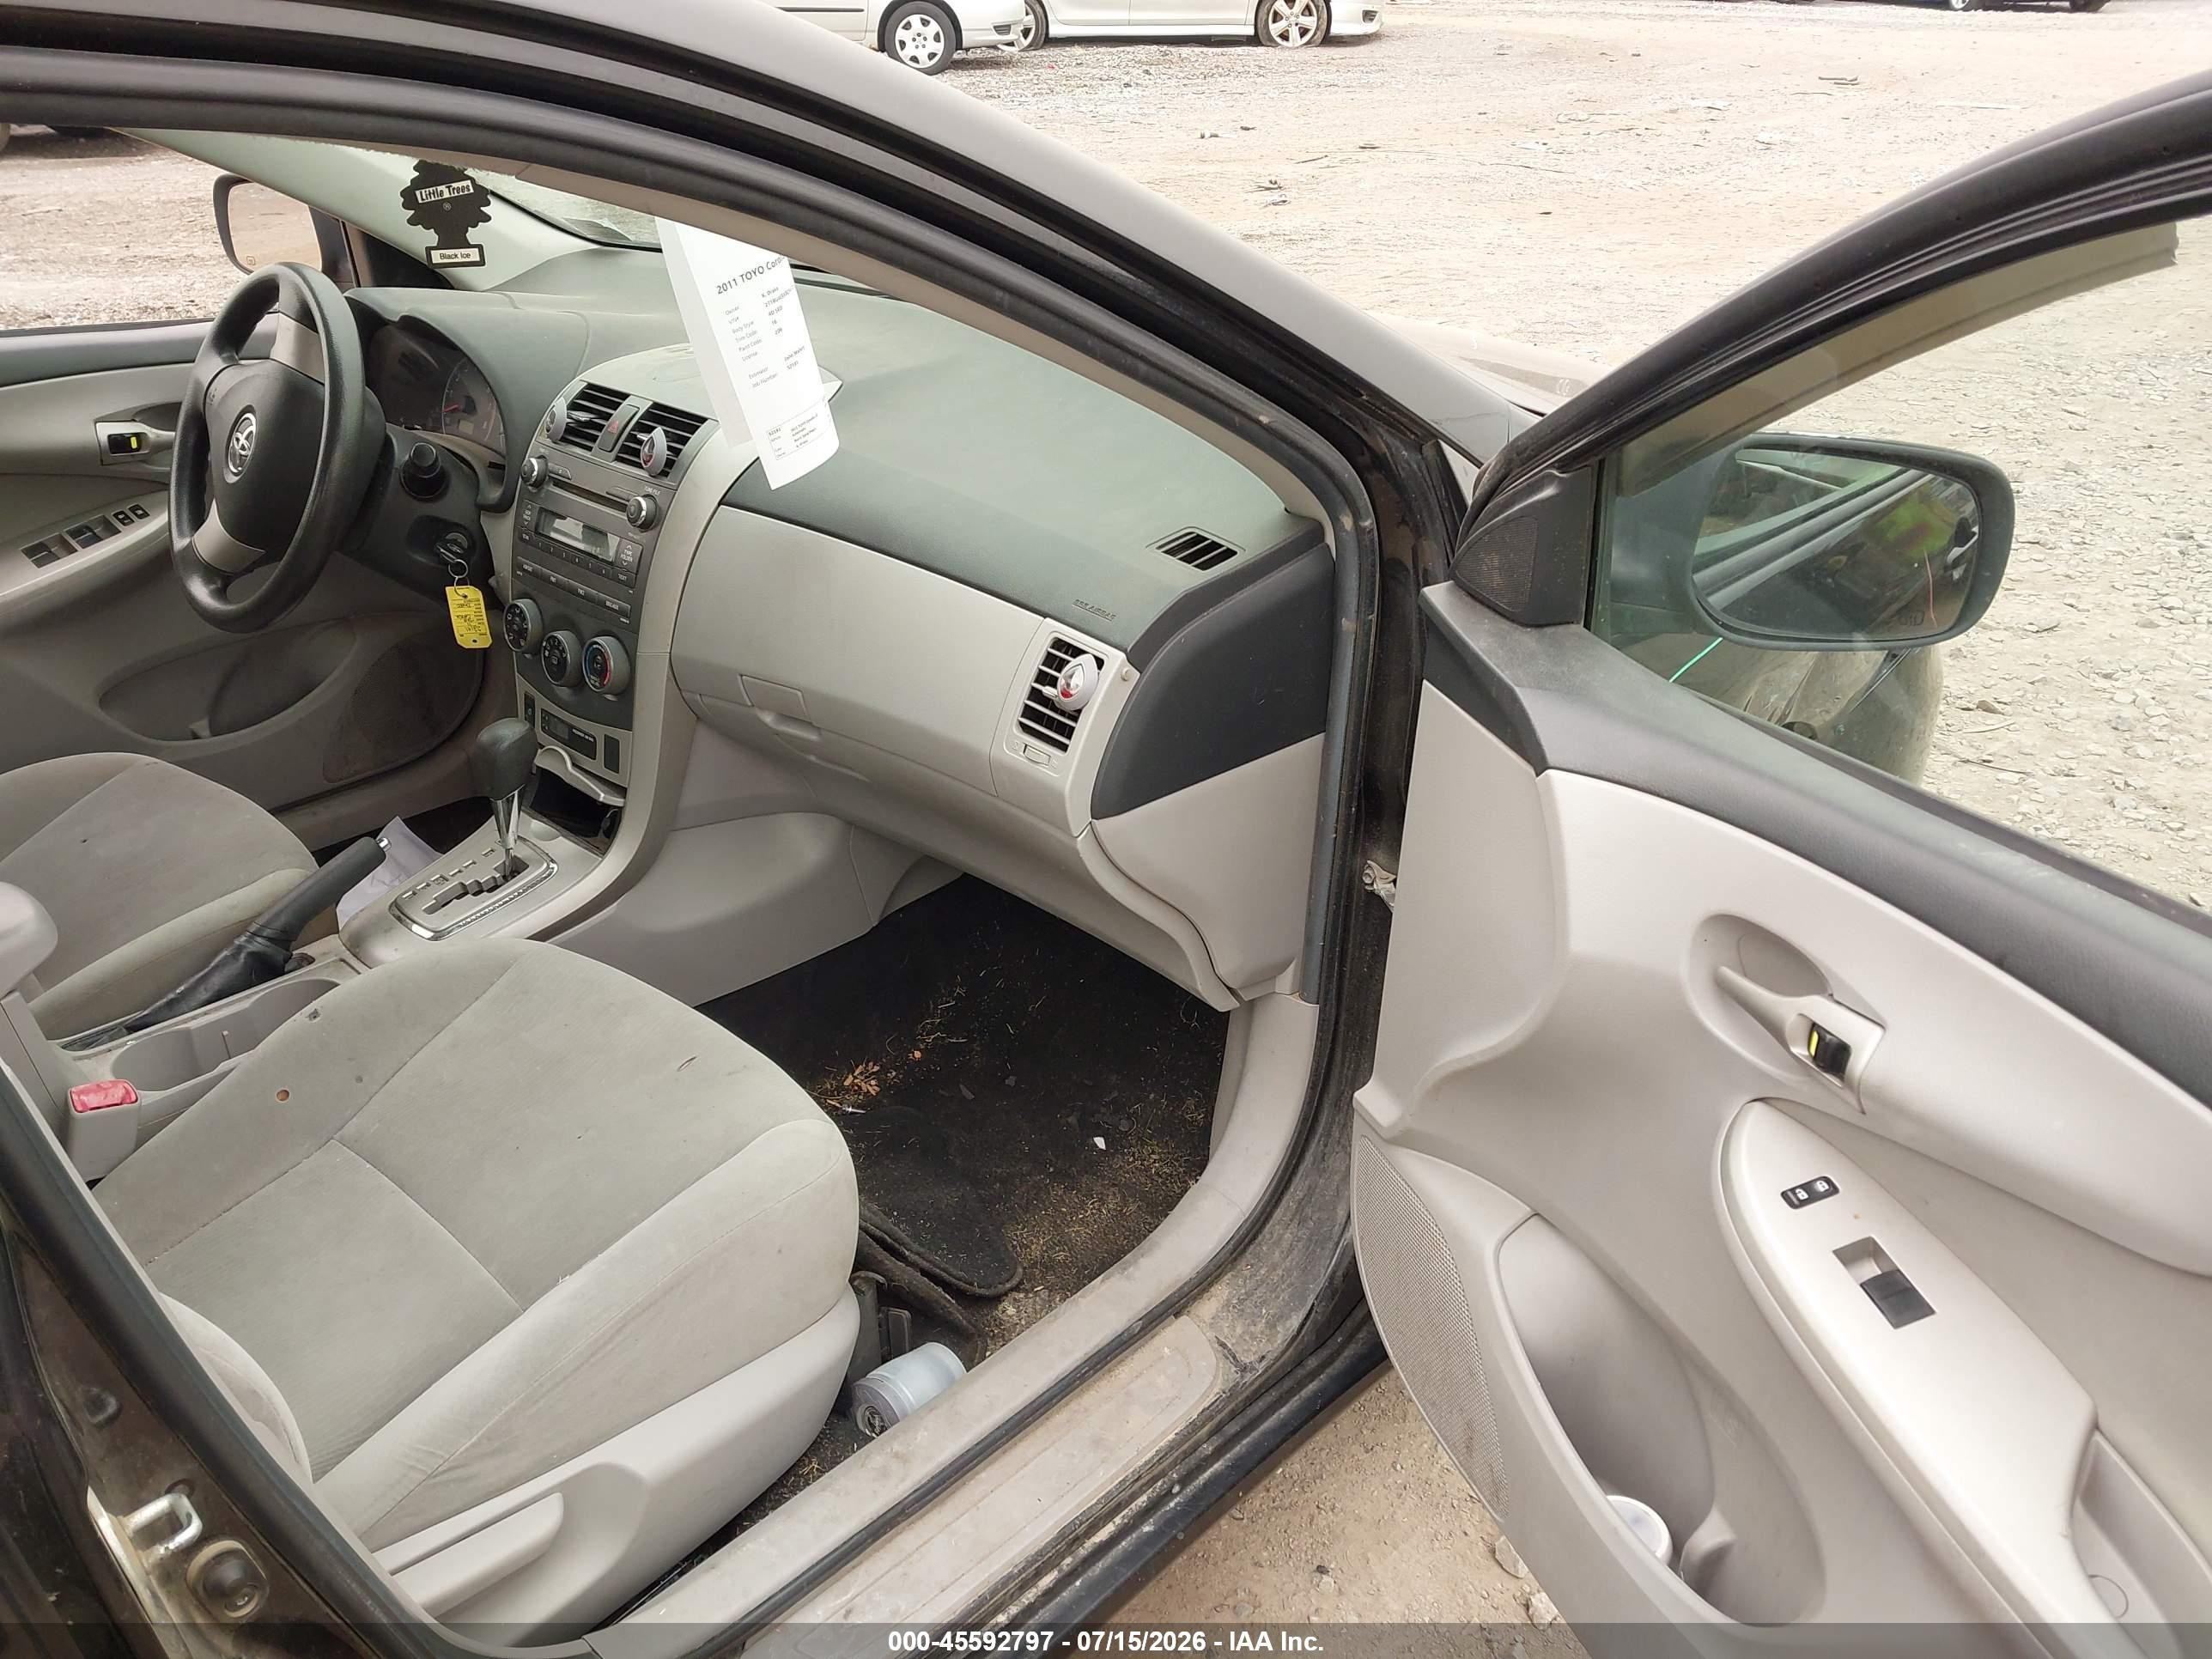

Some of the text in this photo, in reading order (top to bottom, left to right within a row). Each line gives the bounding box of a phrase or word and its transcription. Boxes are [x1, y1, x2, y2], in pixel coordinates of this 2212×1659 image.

[419, 183, 471, 201] Little Trees
[440, 250, 471, 260] Black Ice
[716, 255, 786, 295] 2011 TOYO Coro
